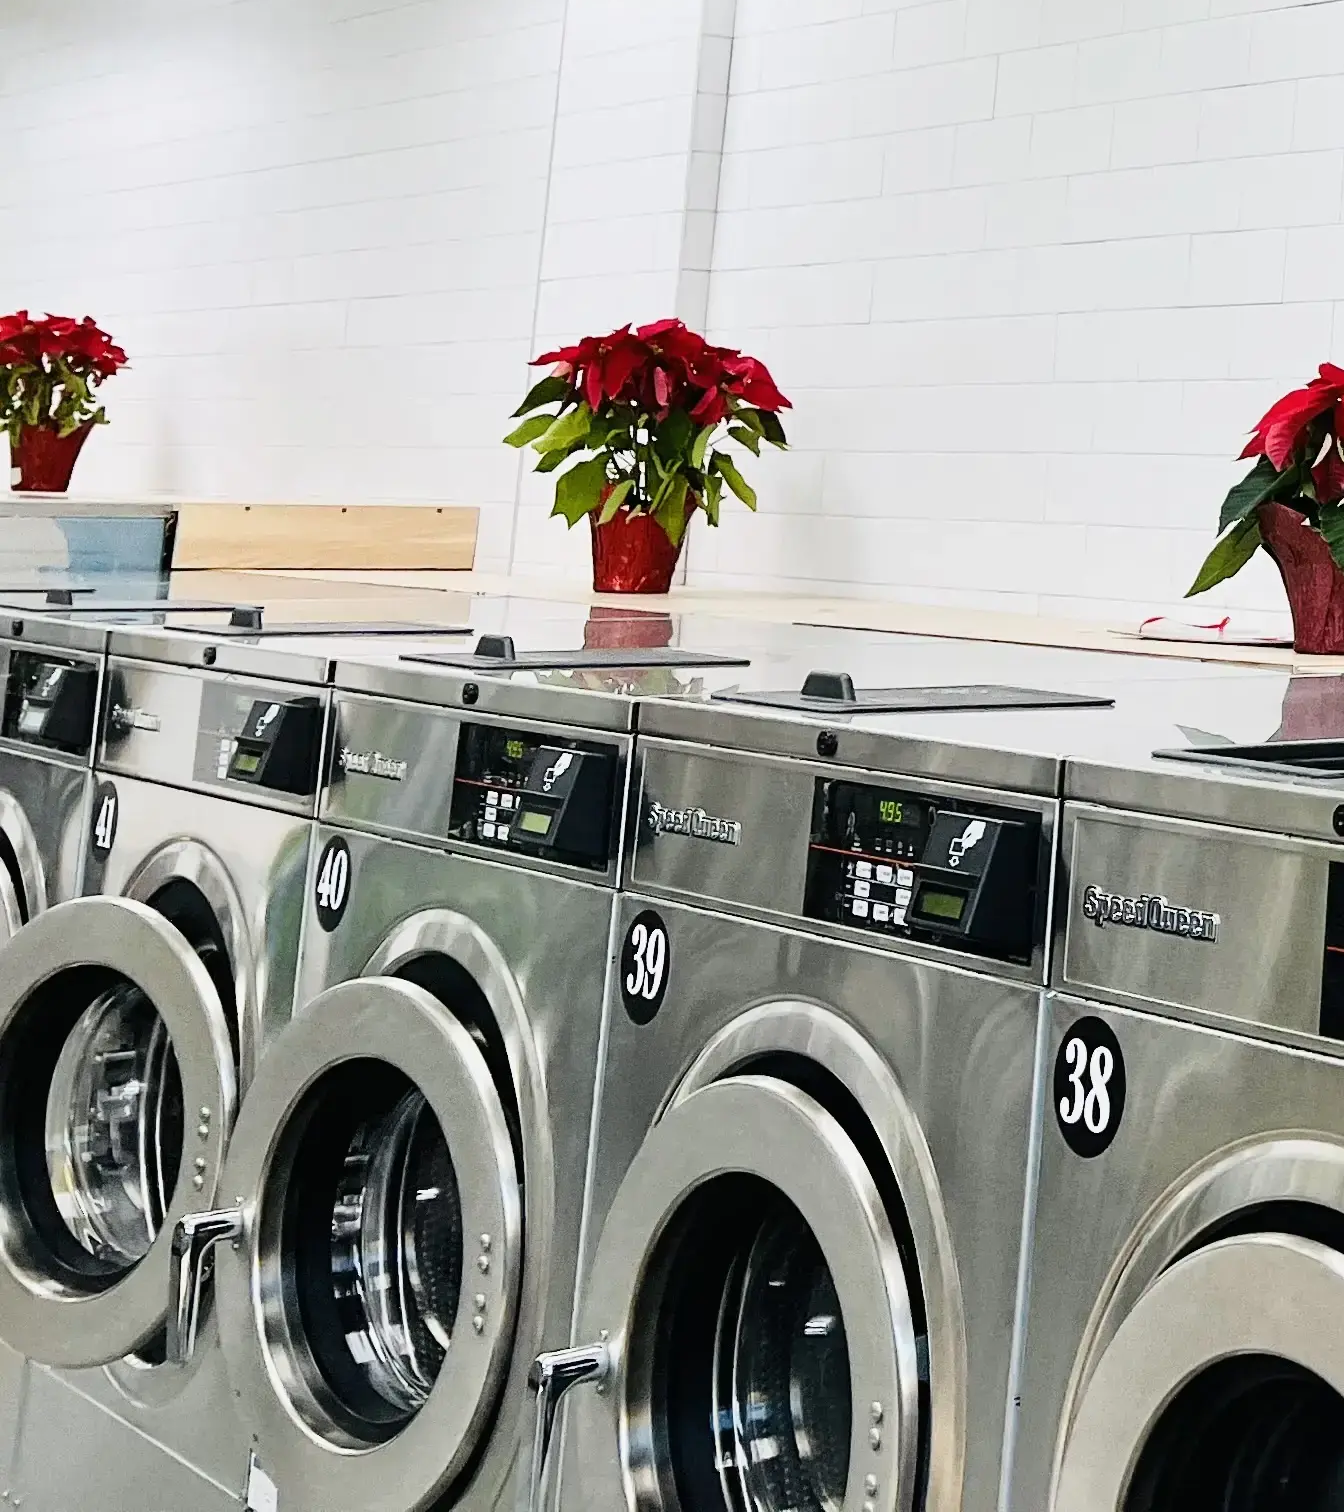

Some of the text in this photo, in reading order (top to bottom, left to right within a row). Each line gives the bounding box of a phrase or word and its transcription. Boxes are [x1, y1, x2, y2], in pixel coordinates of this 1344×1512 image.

[95, 795, 116, 849] 41
[317, 848, 347, 910] 40
[1083, 885, 1221, 944] Speed Queen
[627, 924, 665, 999] 39
[1059, 1037, 1114, 1134] 38
